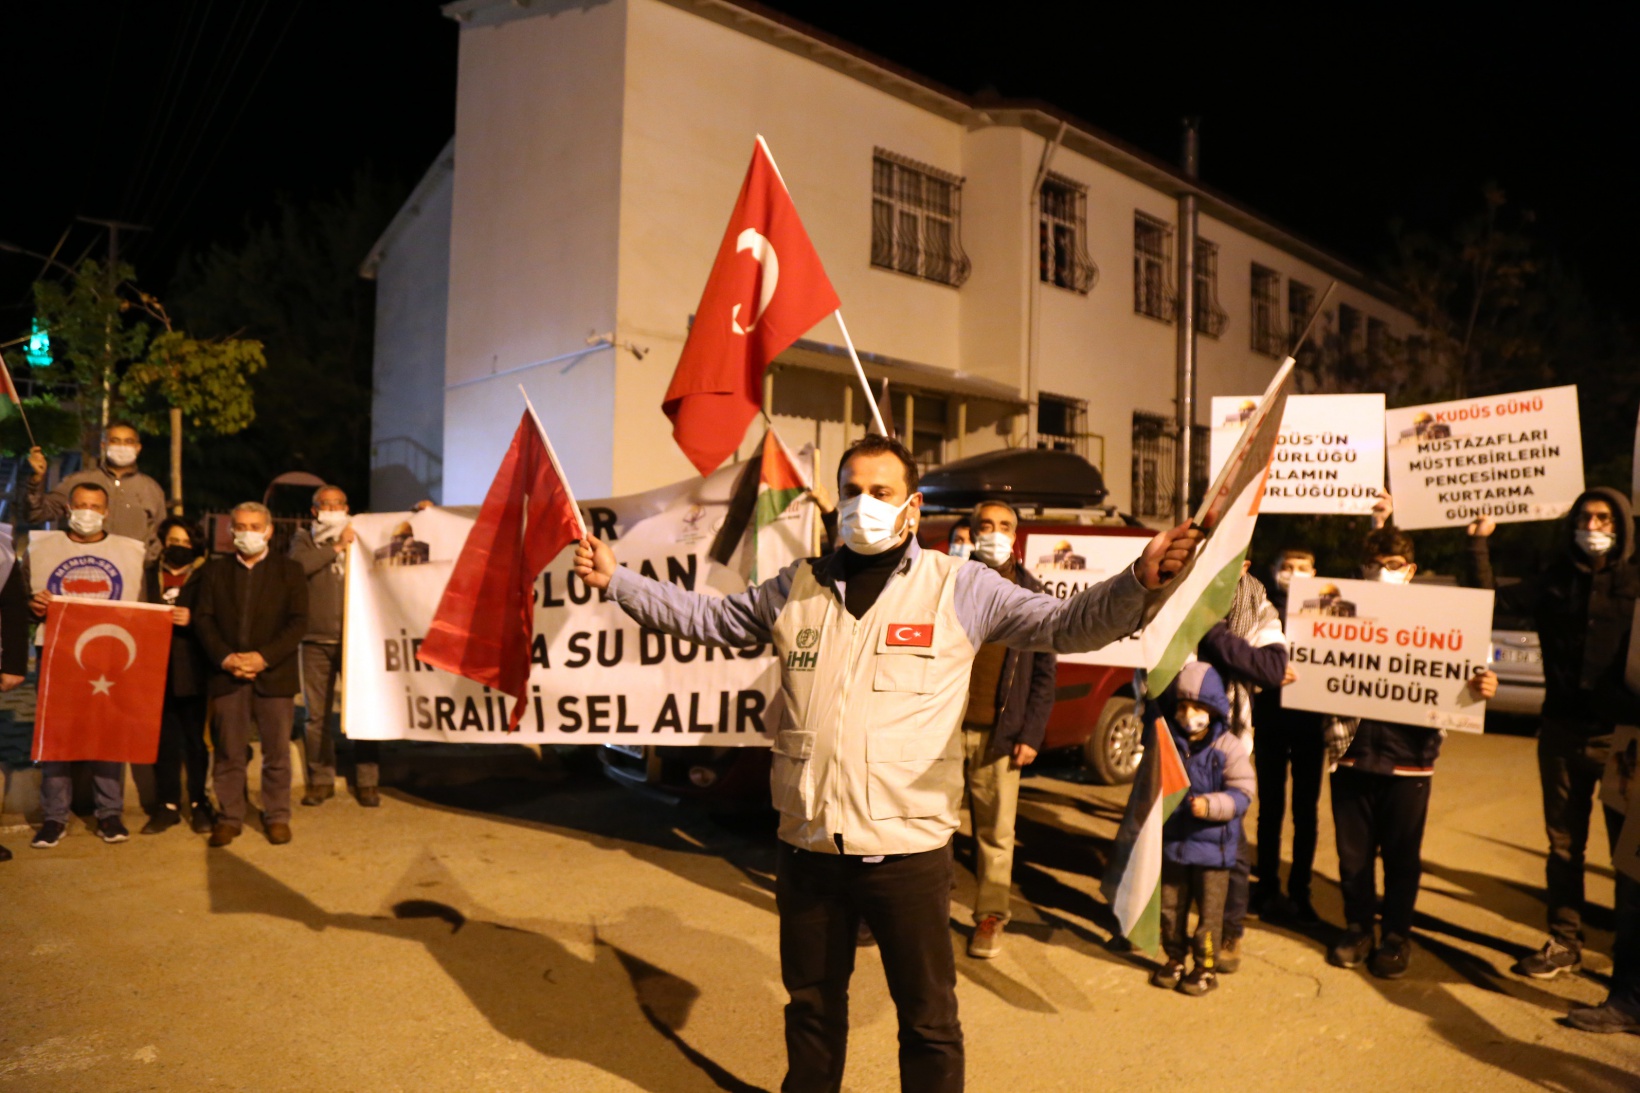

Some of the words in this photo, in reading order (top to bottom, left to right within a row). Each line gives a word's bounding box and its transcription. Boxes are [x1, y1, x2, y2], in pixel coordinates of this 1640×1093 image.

[1435, 403, 1491, 424] KUDÜS
[1496, 396, 1544, 417] GÜNÜ
[1275, 431, 1349, 446] DÜS'ÜN
[1409, 445, 1561, 472] MÜSTEKBİRLERİN
[1425, 465, 1546, 488] PENÇESİNDEN
[1438, 485, 1535, 503] KURTARMA
[1446, 502, 1530, 521] GÜNÜDÜR
[564, 628, 623, 669] SU
[1312, 621, 1389, 645] KUDÜS
[1396, 625, 1464, 653] GÜNÜ
[1289, 641, 1381, 672] İSLAMIN
[1326, 673, 1439, 706] GÜNÜDÜR
[558, 694, 639, 733] SEL
[651, 689, 767, 734] ALIR
